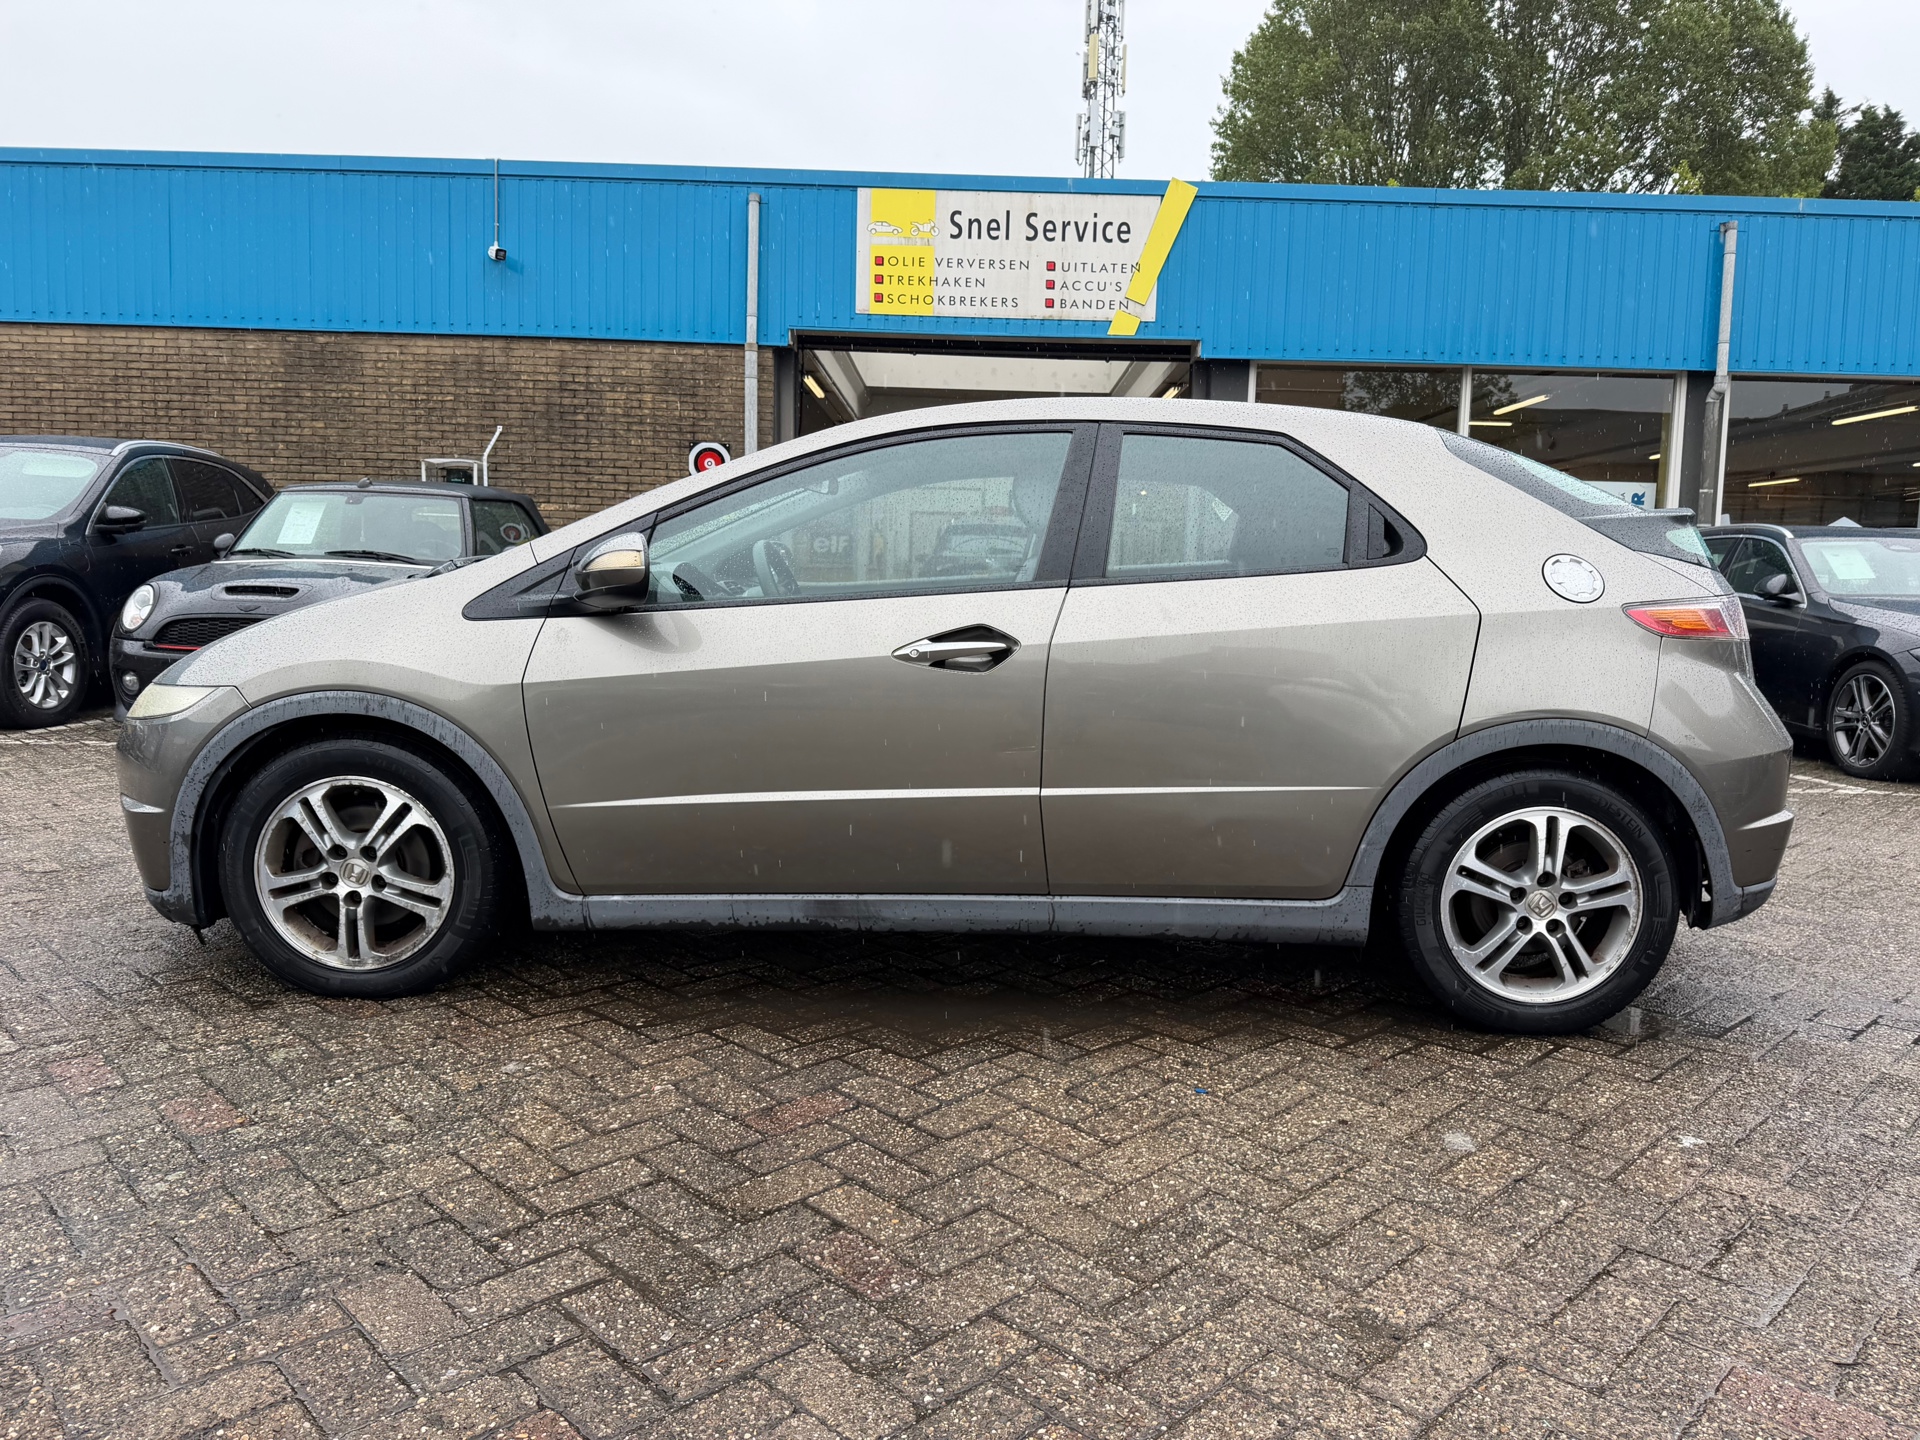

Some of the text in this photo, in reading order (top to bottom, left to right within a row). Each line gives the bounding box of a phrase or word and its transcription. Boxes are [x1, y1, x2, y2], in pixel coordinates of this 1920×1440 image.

[949, 210, 1131, 244] Snel Service
[887, 256, 1030, 271] OLIE VERVERSEN
[1061, 262, 1141, 274] UITLATEN
[887, 275, 986, 288] TREKHAKEN
[1059, 280, 1122, 293] ACCU'S
[886, 293, 1019, 308] SCHOKBREKERS
[1059, 298, 1129, 311] BANDEN
[813, 535, 850, 554] elf
